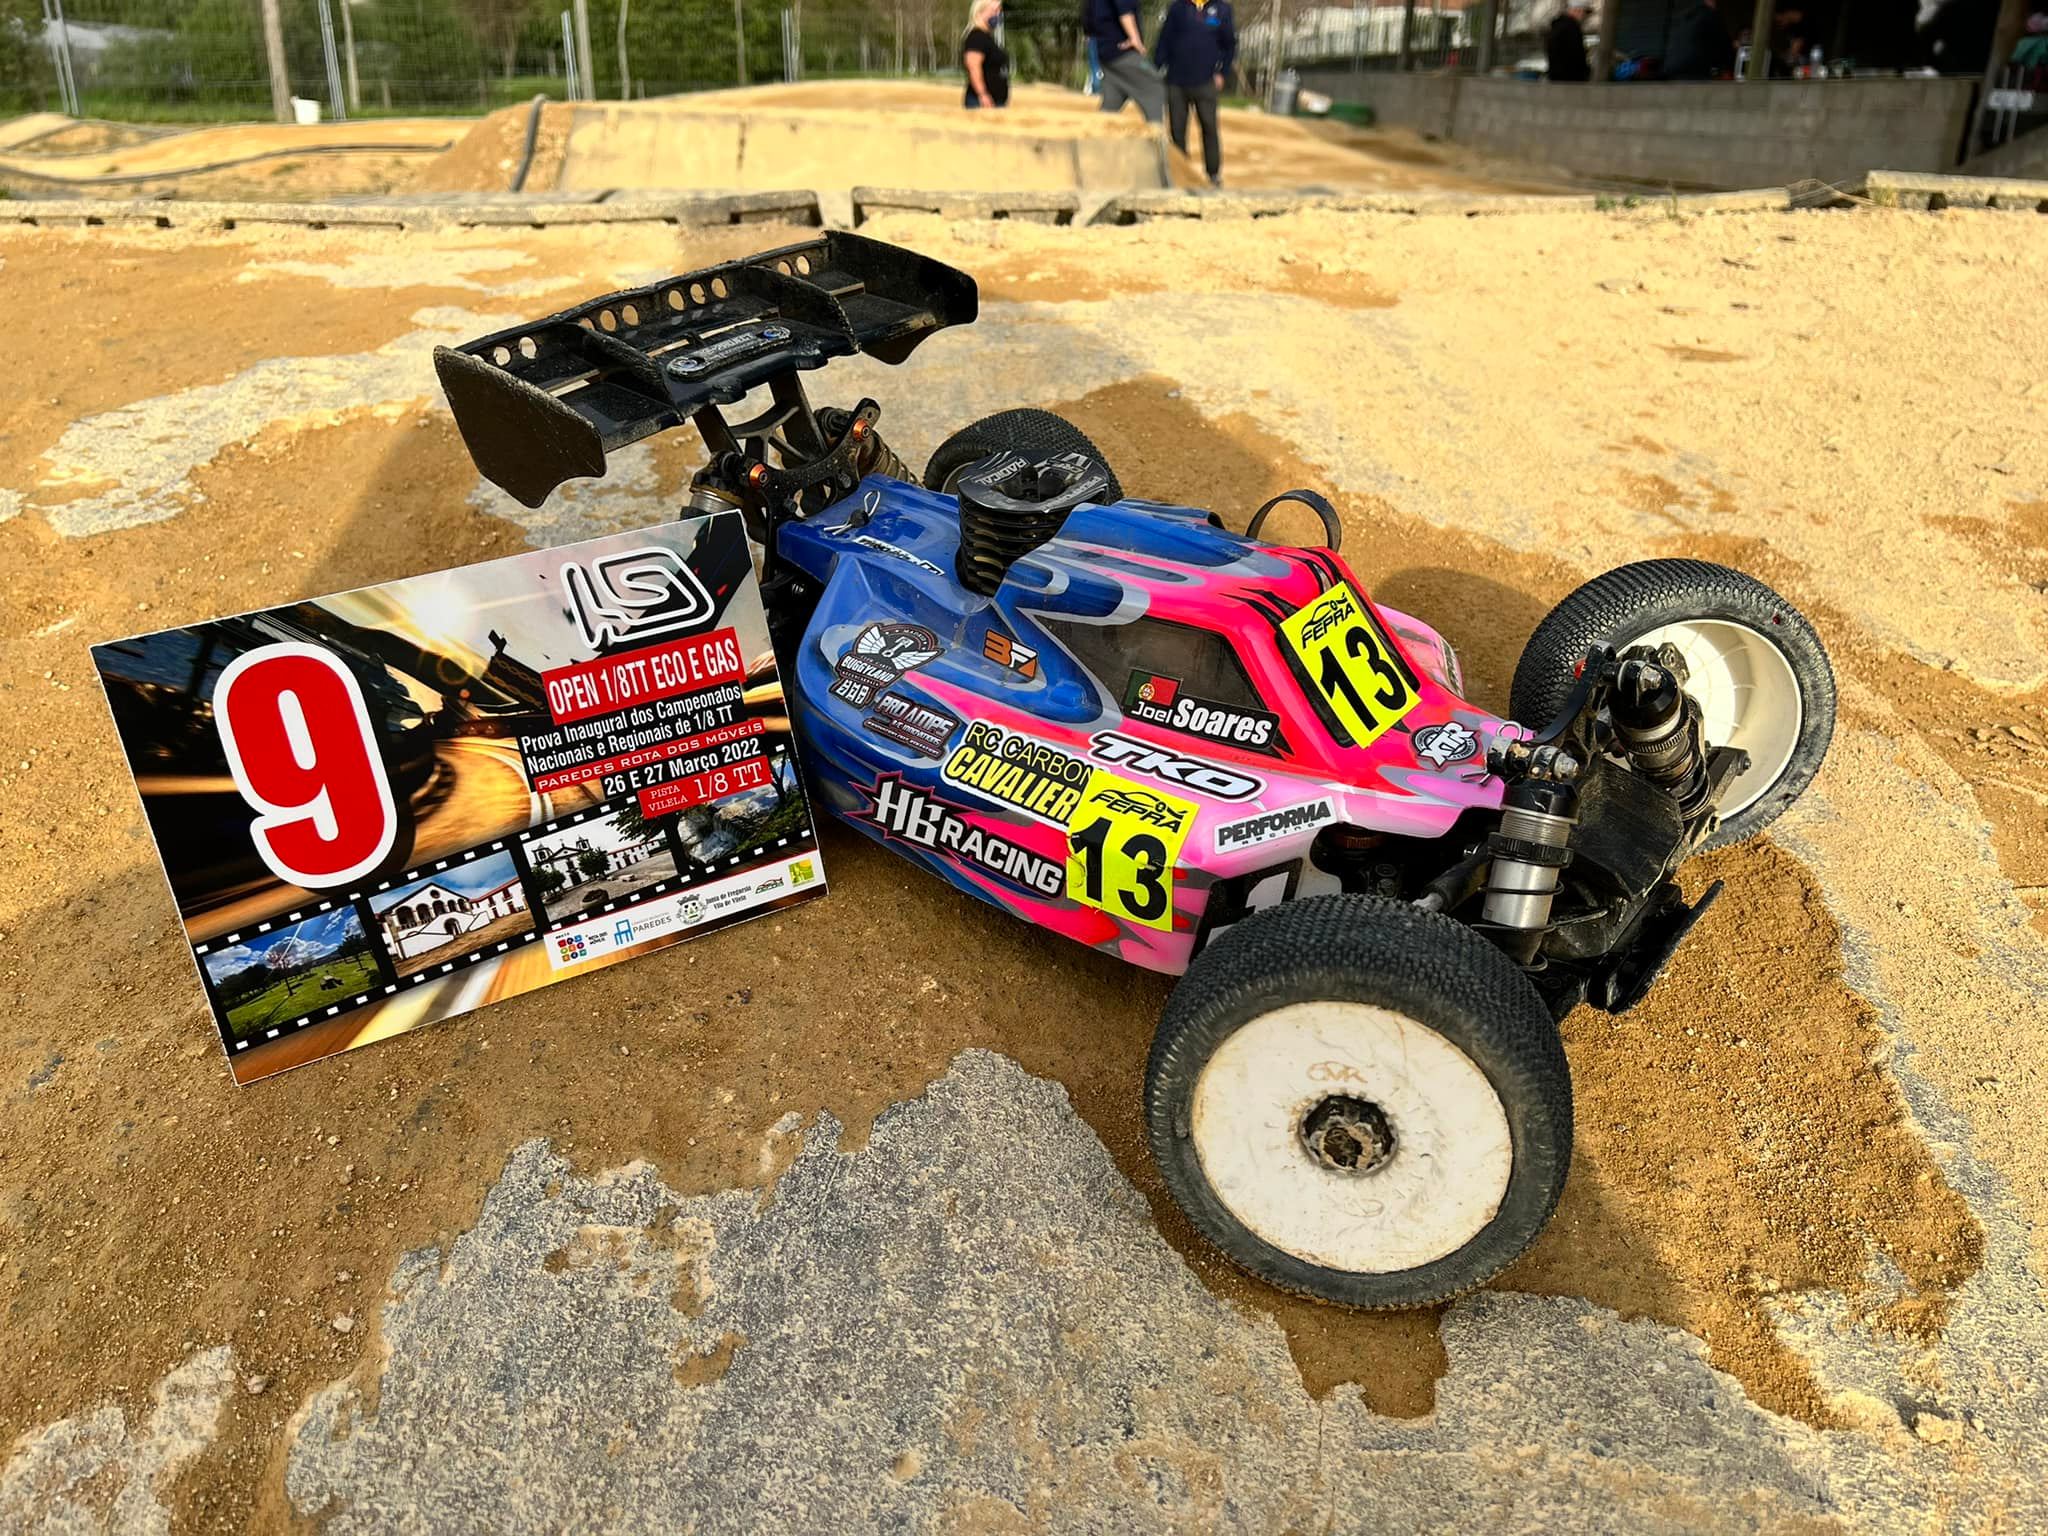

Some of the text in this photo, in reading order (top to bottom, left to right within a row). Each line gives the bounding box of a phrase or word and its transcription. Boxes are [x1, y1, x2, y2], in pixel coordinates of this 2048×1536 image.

[1301, 602, 1356, 650] FEPRA
[548, 638, 740, 715] OPEN 1/8TT ECO E GAS
[841, 655, 896, 683] BUGGYLAND
[1319, 626, 1407, 732] 13
[521, 685, 741, 754] Prova Inaugural dos Campeonatos
[879, 695, 911, 717] PRO
[1131, 698, 1272, 744] Joel Soares
[526, 705, 733, 774] Nacionais e Regionais de 1/8 TT
[538, 721, 763, 790] PAREDES ROTA DOS MÓVEIS
[967, 723, 1003, 751] RC
[219, 648, 391, 882] 9
[604, 737, 761, 796] 26 E 27 Março 2022
[650, 761, 763, 800] PISTA 1/8 TT
[1097, 734, 1256, 796] TKO
[648, 795, 688, 812] VILELA
[1090, 791, 1182, 834] FEPRA
[1218, 801, 1332, 847] PERFORMA
[939, 816, 1064, 894] RACING
[1070, 816, 1168, 922] 13
[633, 916, 672, 934] PAREDES
